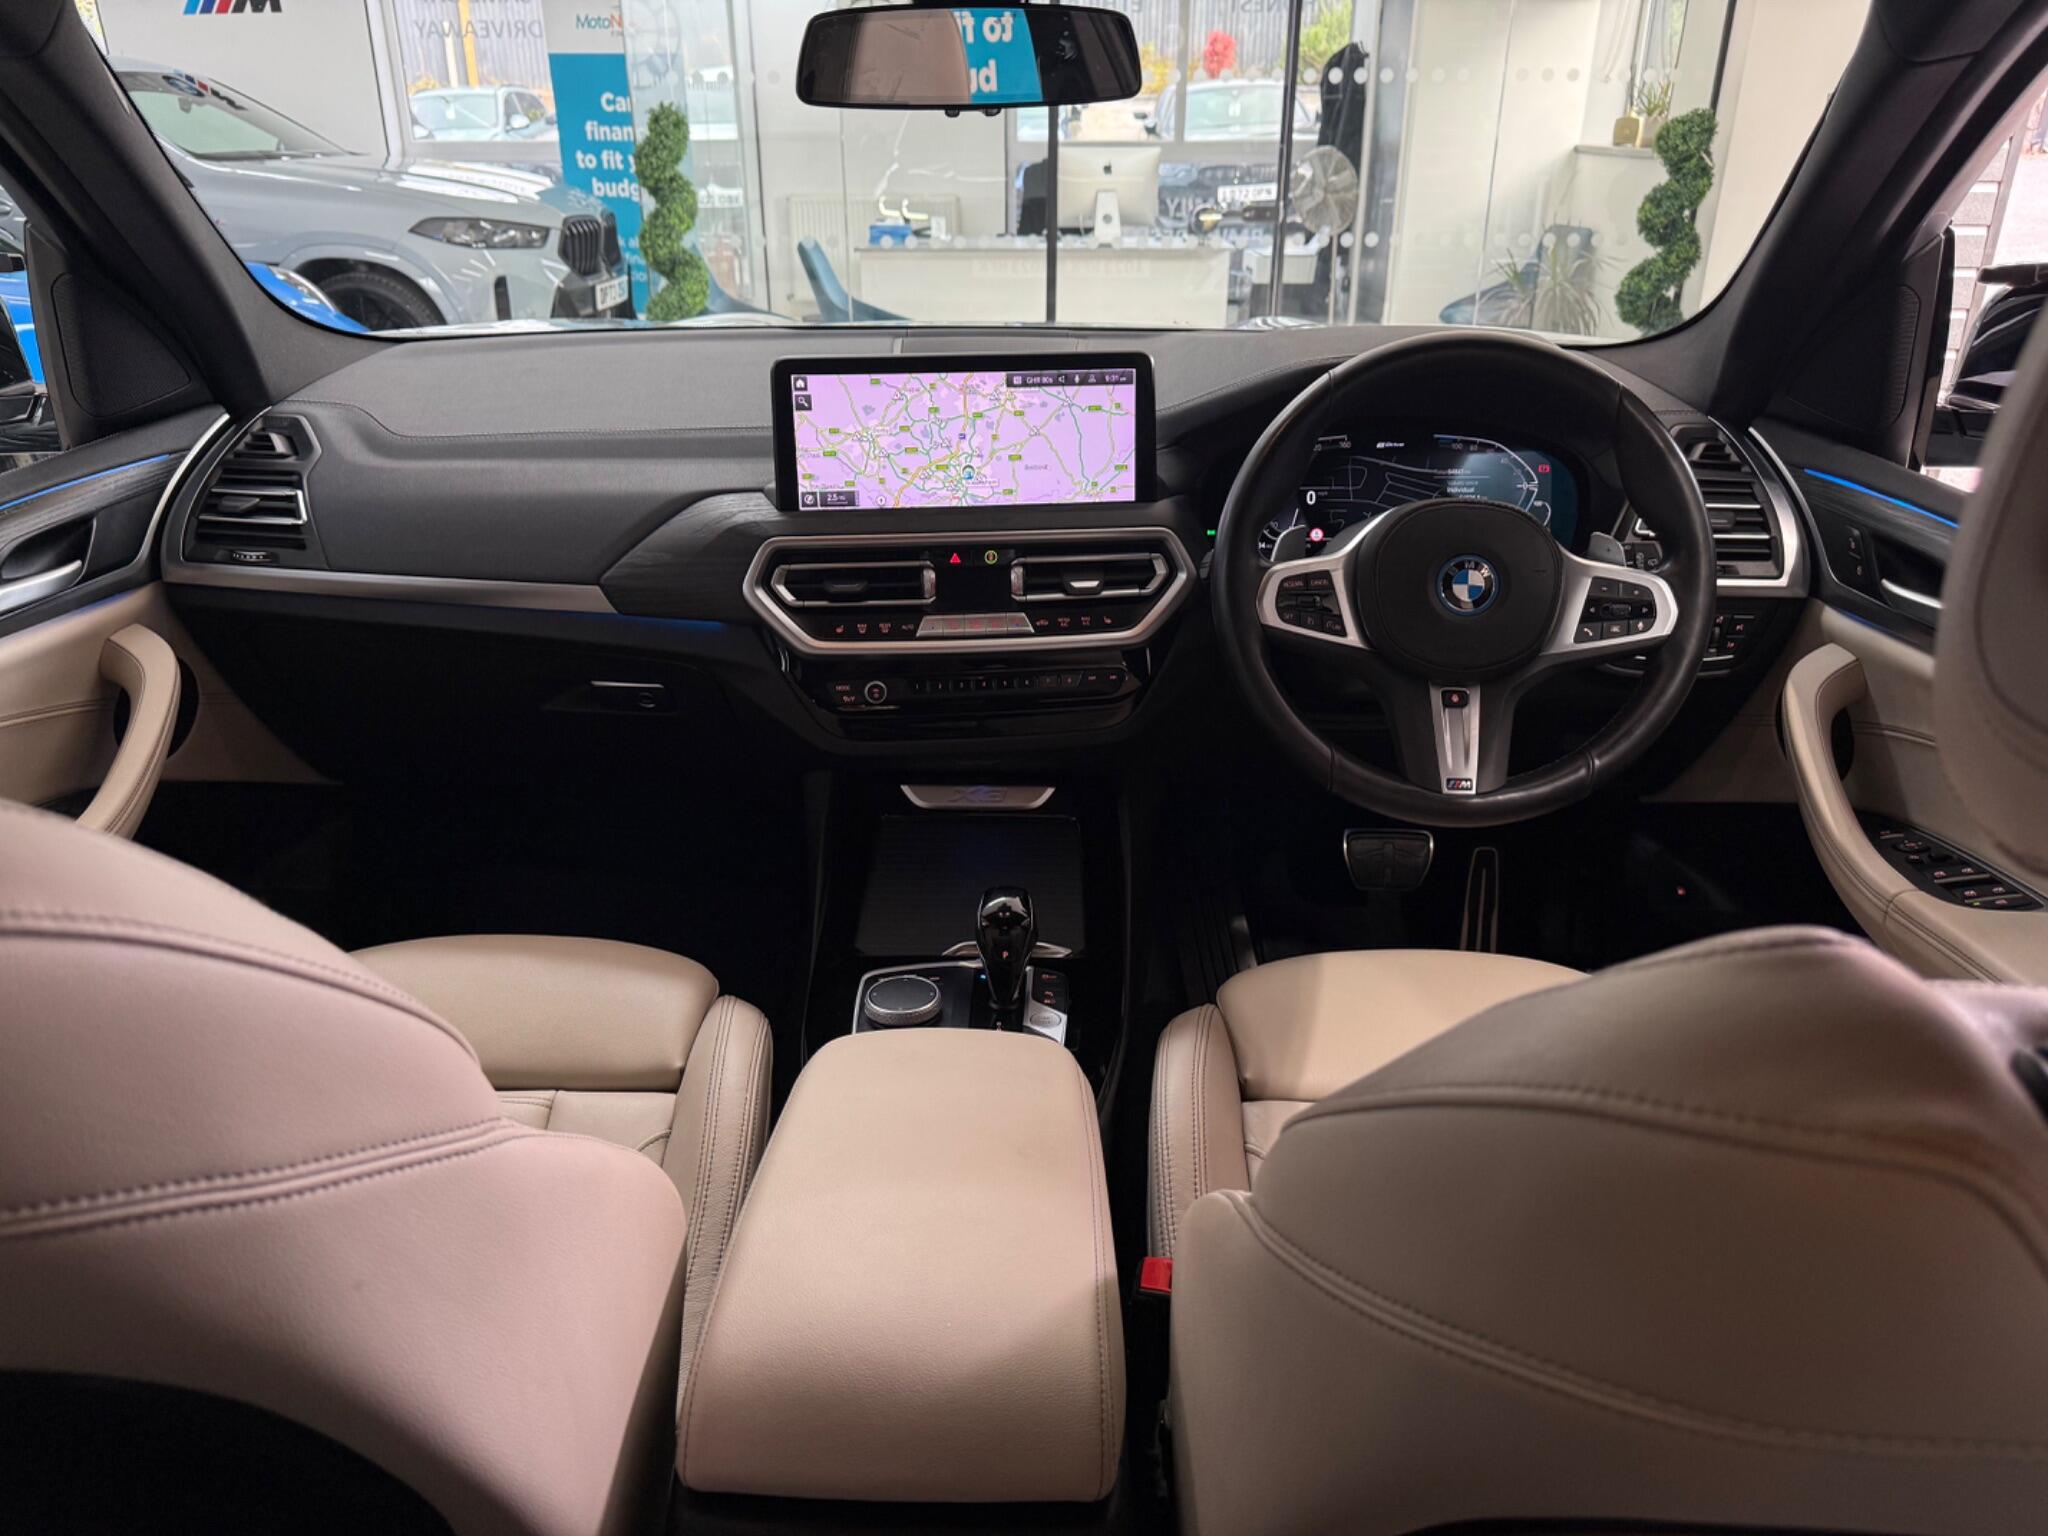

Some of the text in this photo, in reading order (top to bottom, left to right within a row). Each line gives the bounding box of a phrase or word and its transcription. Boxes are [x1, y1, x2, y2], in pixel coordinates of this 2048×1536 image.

[575, 14, 623, 30] MotoN
[584, 120, 634, 141] finan
[576, 149, 597, 169] to
[602, 149, 625, 170] fit
[591, 176, 640, 202] budg
